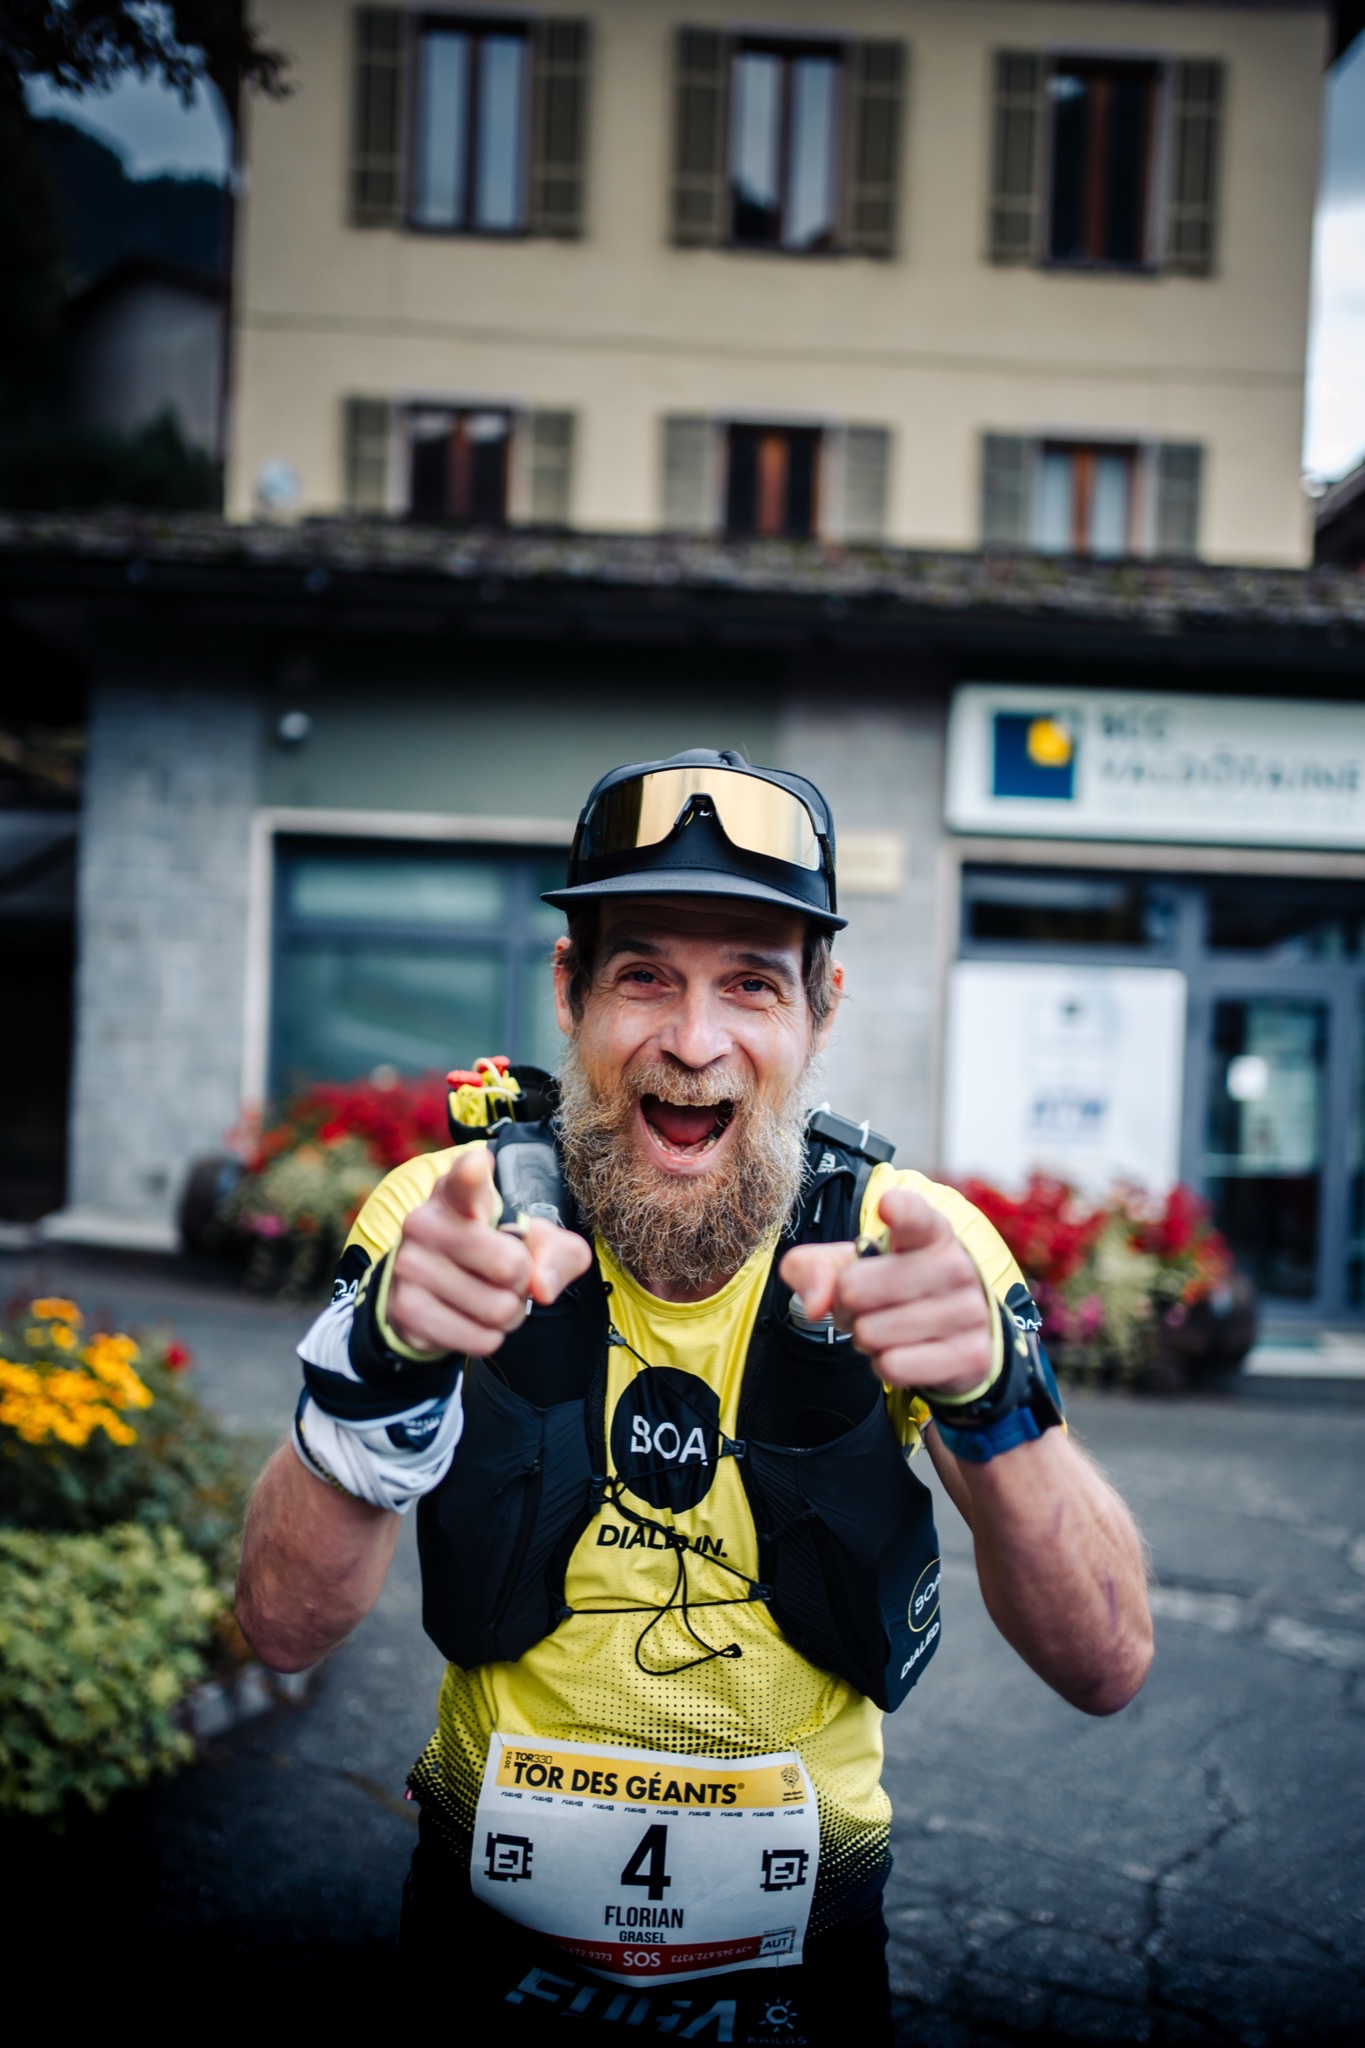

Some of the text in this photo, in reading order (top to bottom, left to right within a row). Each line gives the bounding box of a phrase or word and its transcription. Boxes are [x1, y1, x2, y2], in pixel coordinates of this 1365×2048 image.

[630, 1415, 708, 1465] BOA
[900, 1621, 940, 1680] DIALED
[504, 1751, 513, 1769] 2025
[515, 1752, 553, 1765] TOR330
[514, 1762, 564, 1790] TOR
[571, 1769, 619, 1796] DES
[620, 1824, 671, 1901] 4
[604, 1905, 684, 1928] FLORIAN
[619, 1930, 667, 1944] GRASEL
[763, 1937, 789, 1949] AUT
[622, 1951, 661, 1967] SOS
[747, 2035, 808, 2046] KAILAS
